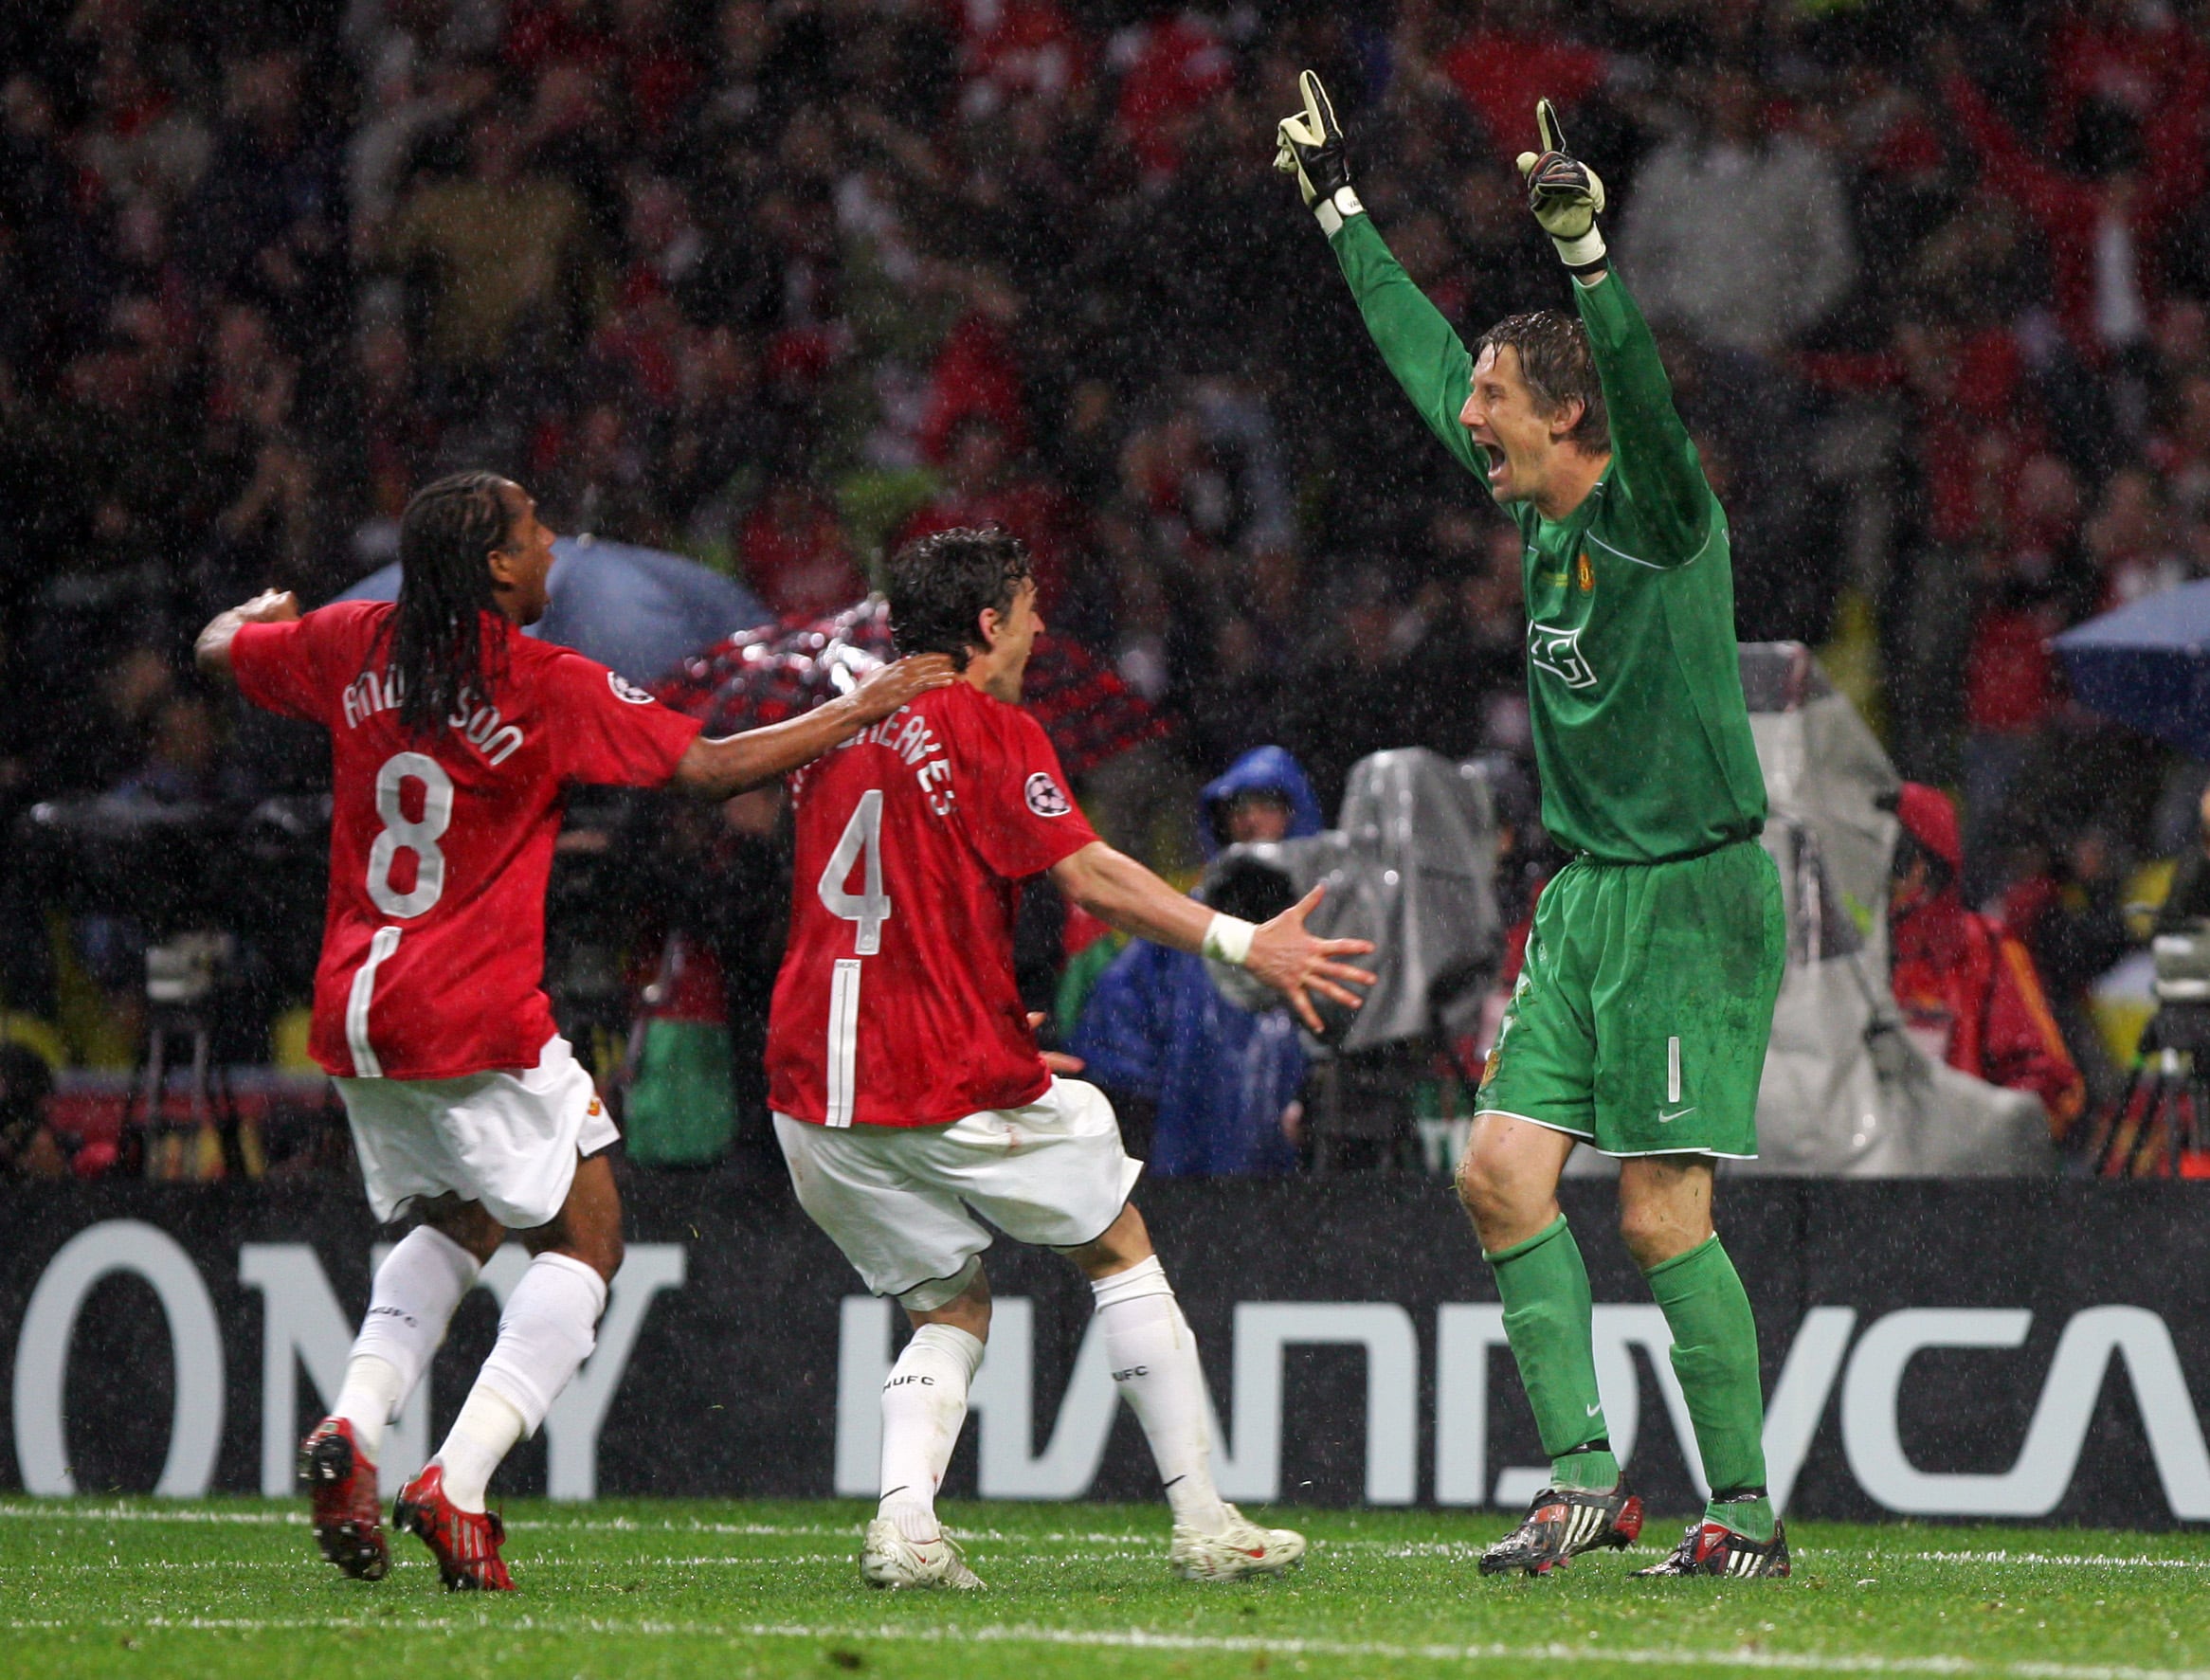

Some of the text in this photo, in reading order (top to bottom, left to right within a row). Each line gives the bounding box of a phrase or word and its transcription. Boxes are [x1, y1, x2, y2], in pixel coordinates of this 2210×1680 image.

[342, 663, 524, 766] ANDSON
[792, 705, 955, 816] EAVES
[367, 751, 453, 919] 8
[818, 789, 891, 955] 4
